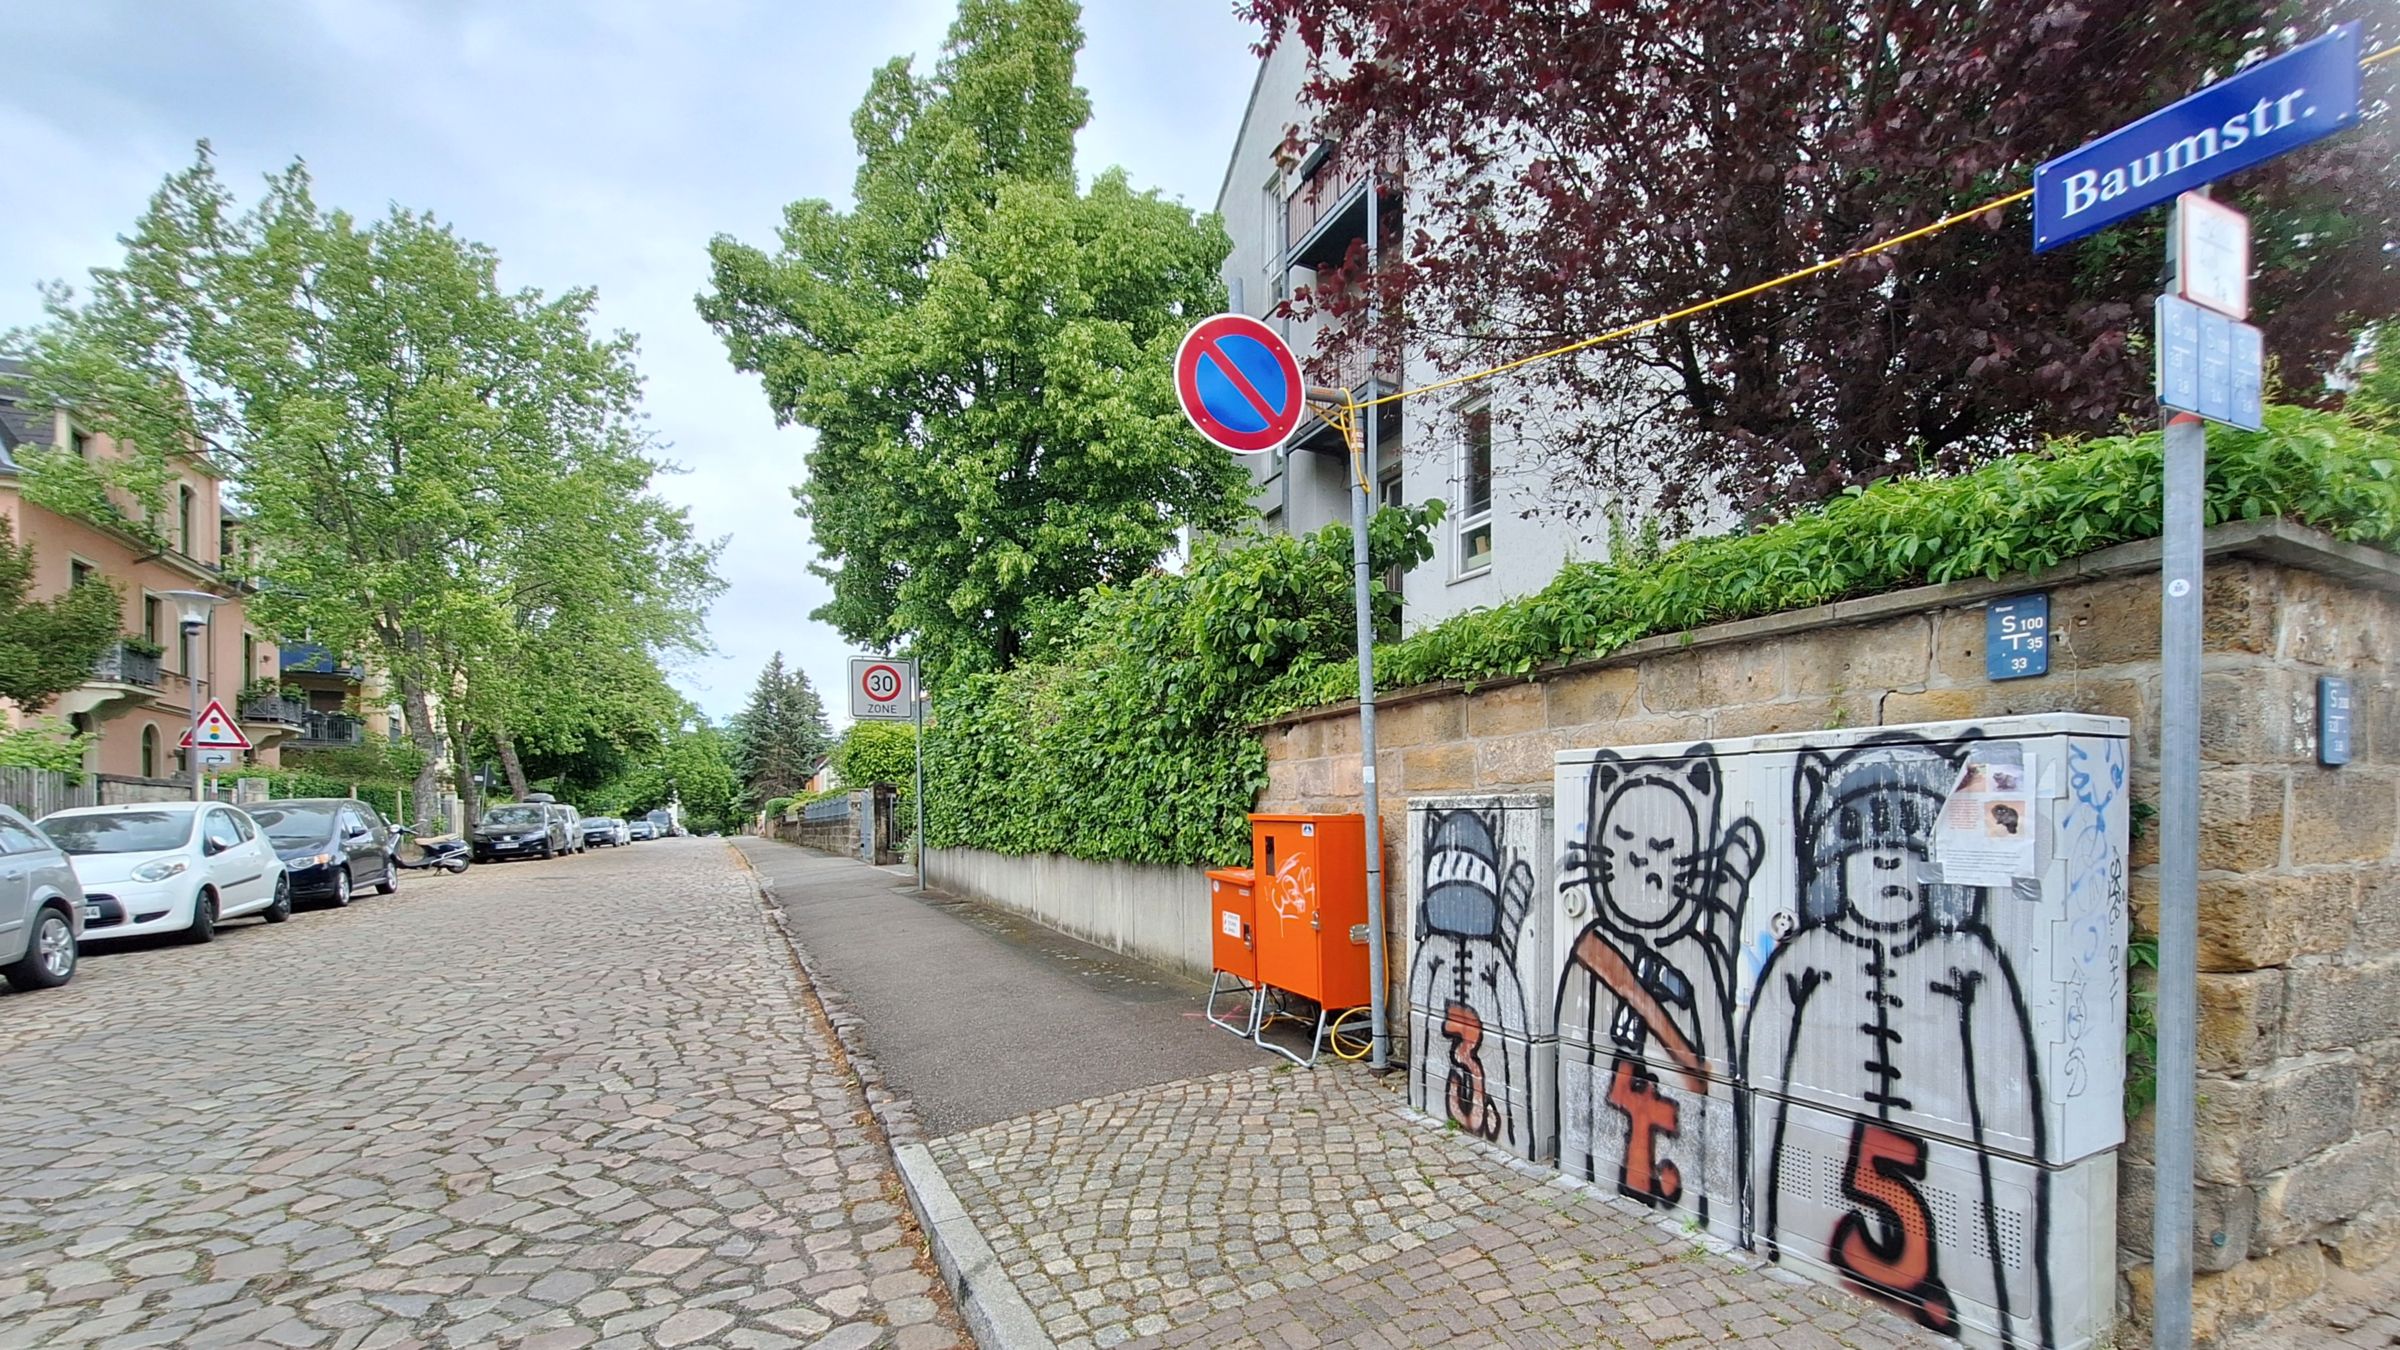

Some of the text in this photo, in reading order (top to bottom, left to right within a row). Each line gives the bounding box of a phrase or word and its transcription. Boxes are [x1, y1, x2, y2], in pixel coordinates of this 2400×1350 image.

[2061, 88, 2317, 220] Baumstr.
[2002, 615, 2044, 633] S 100
[870, 675, 893, 692] 30
[867, 703, 898, 714] ZONE
